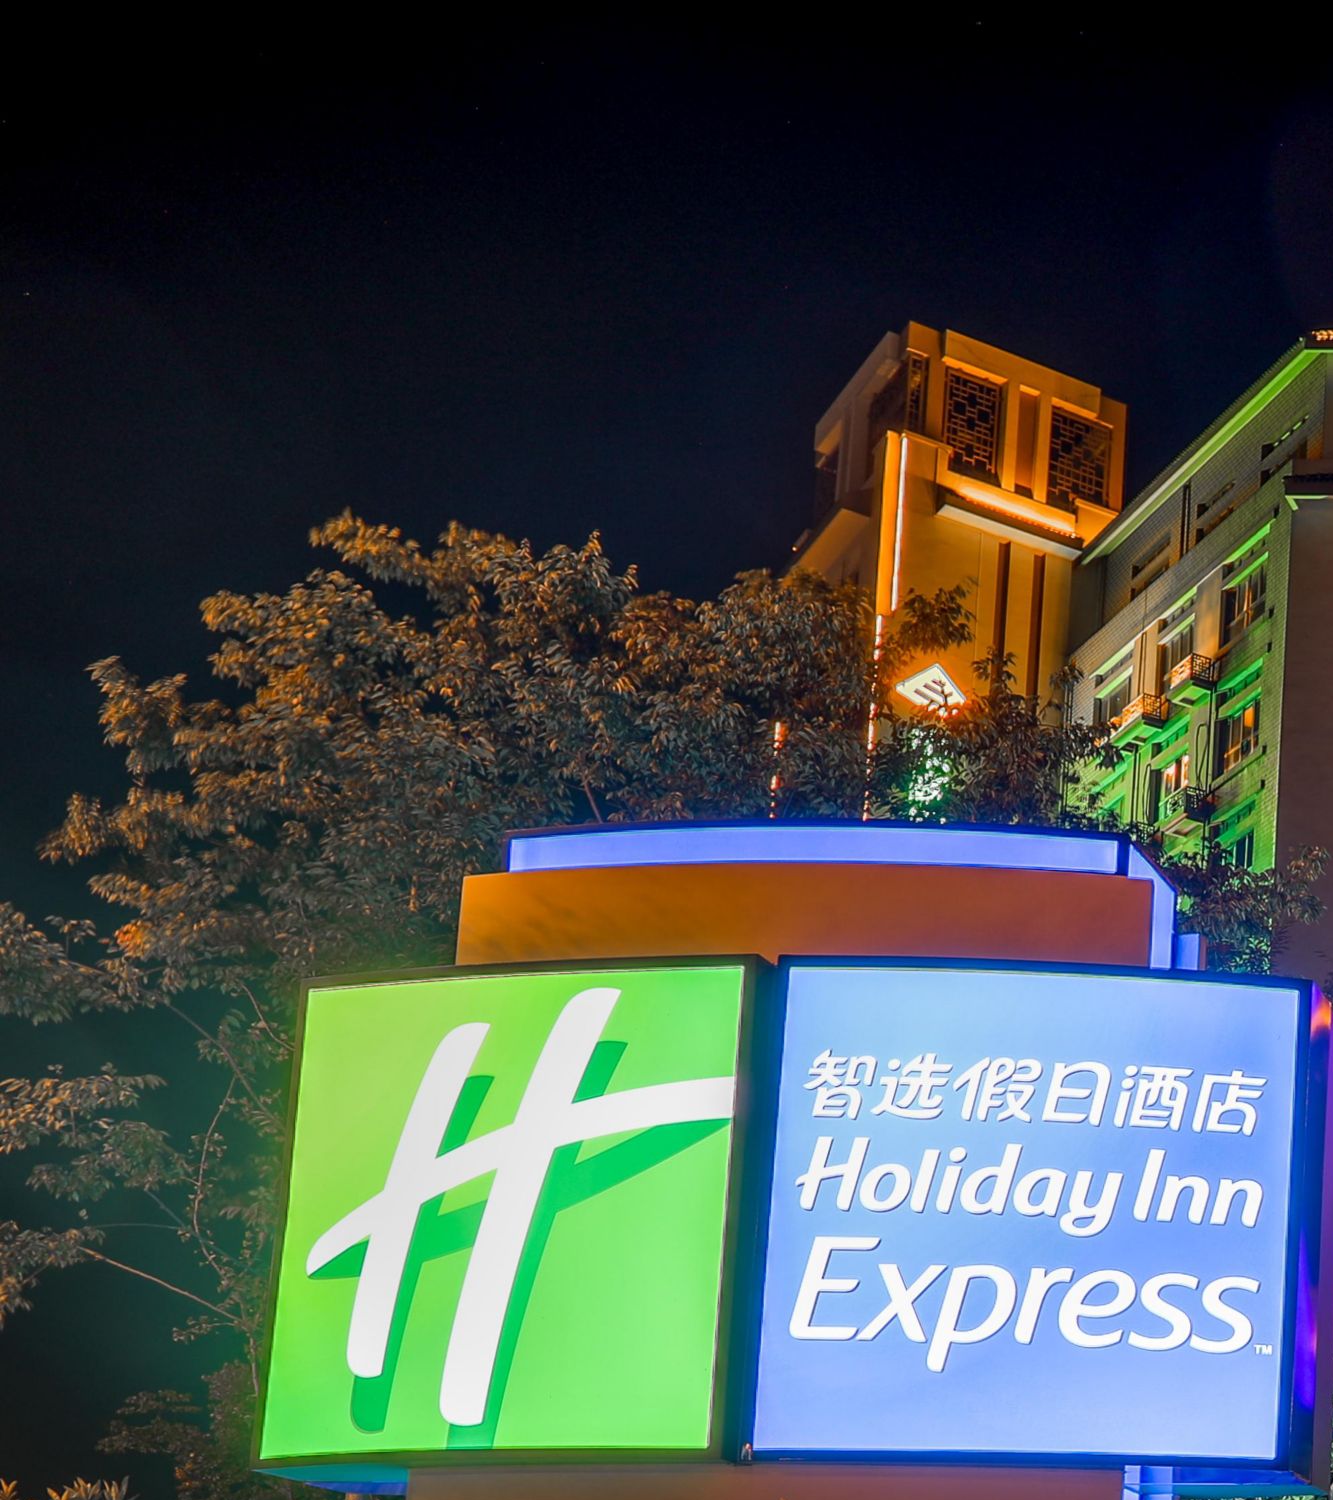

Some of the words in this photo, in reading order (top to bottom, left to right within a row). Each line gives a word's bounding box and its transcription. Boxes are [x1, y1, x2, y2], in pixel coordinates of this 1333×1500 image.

[802, 1046, 1269, 1137] 智选假日酒店
[795, 1135, 1123, 1237] Holiday
[1130, 1146, 1265, 1229] Inn
[787, 1235, 1261, 1373] Express
